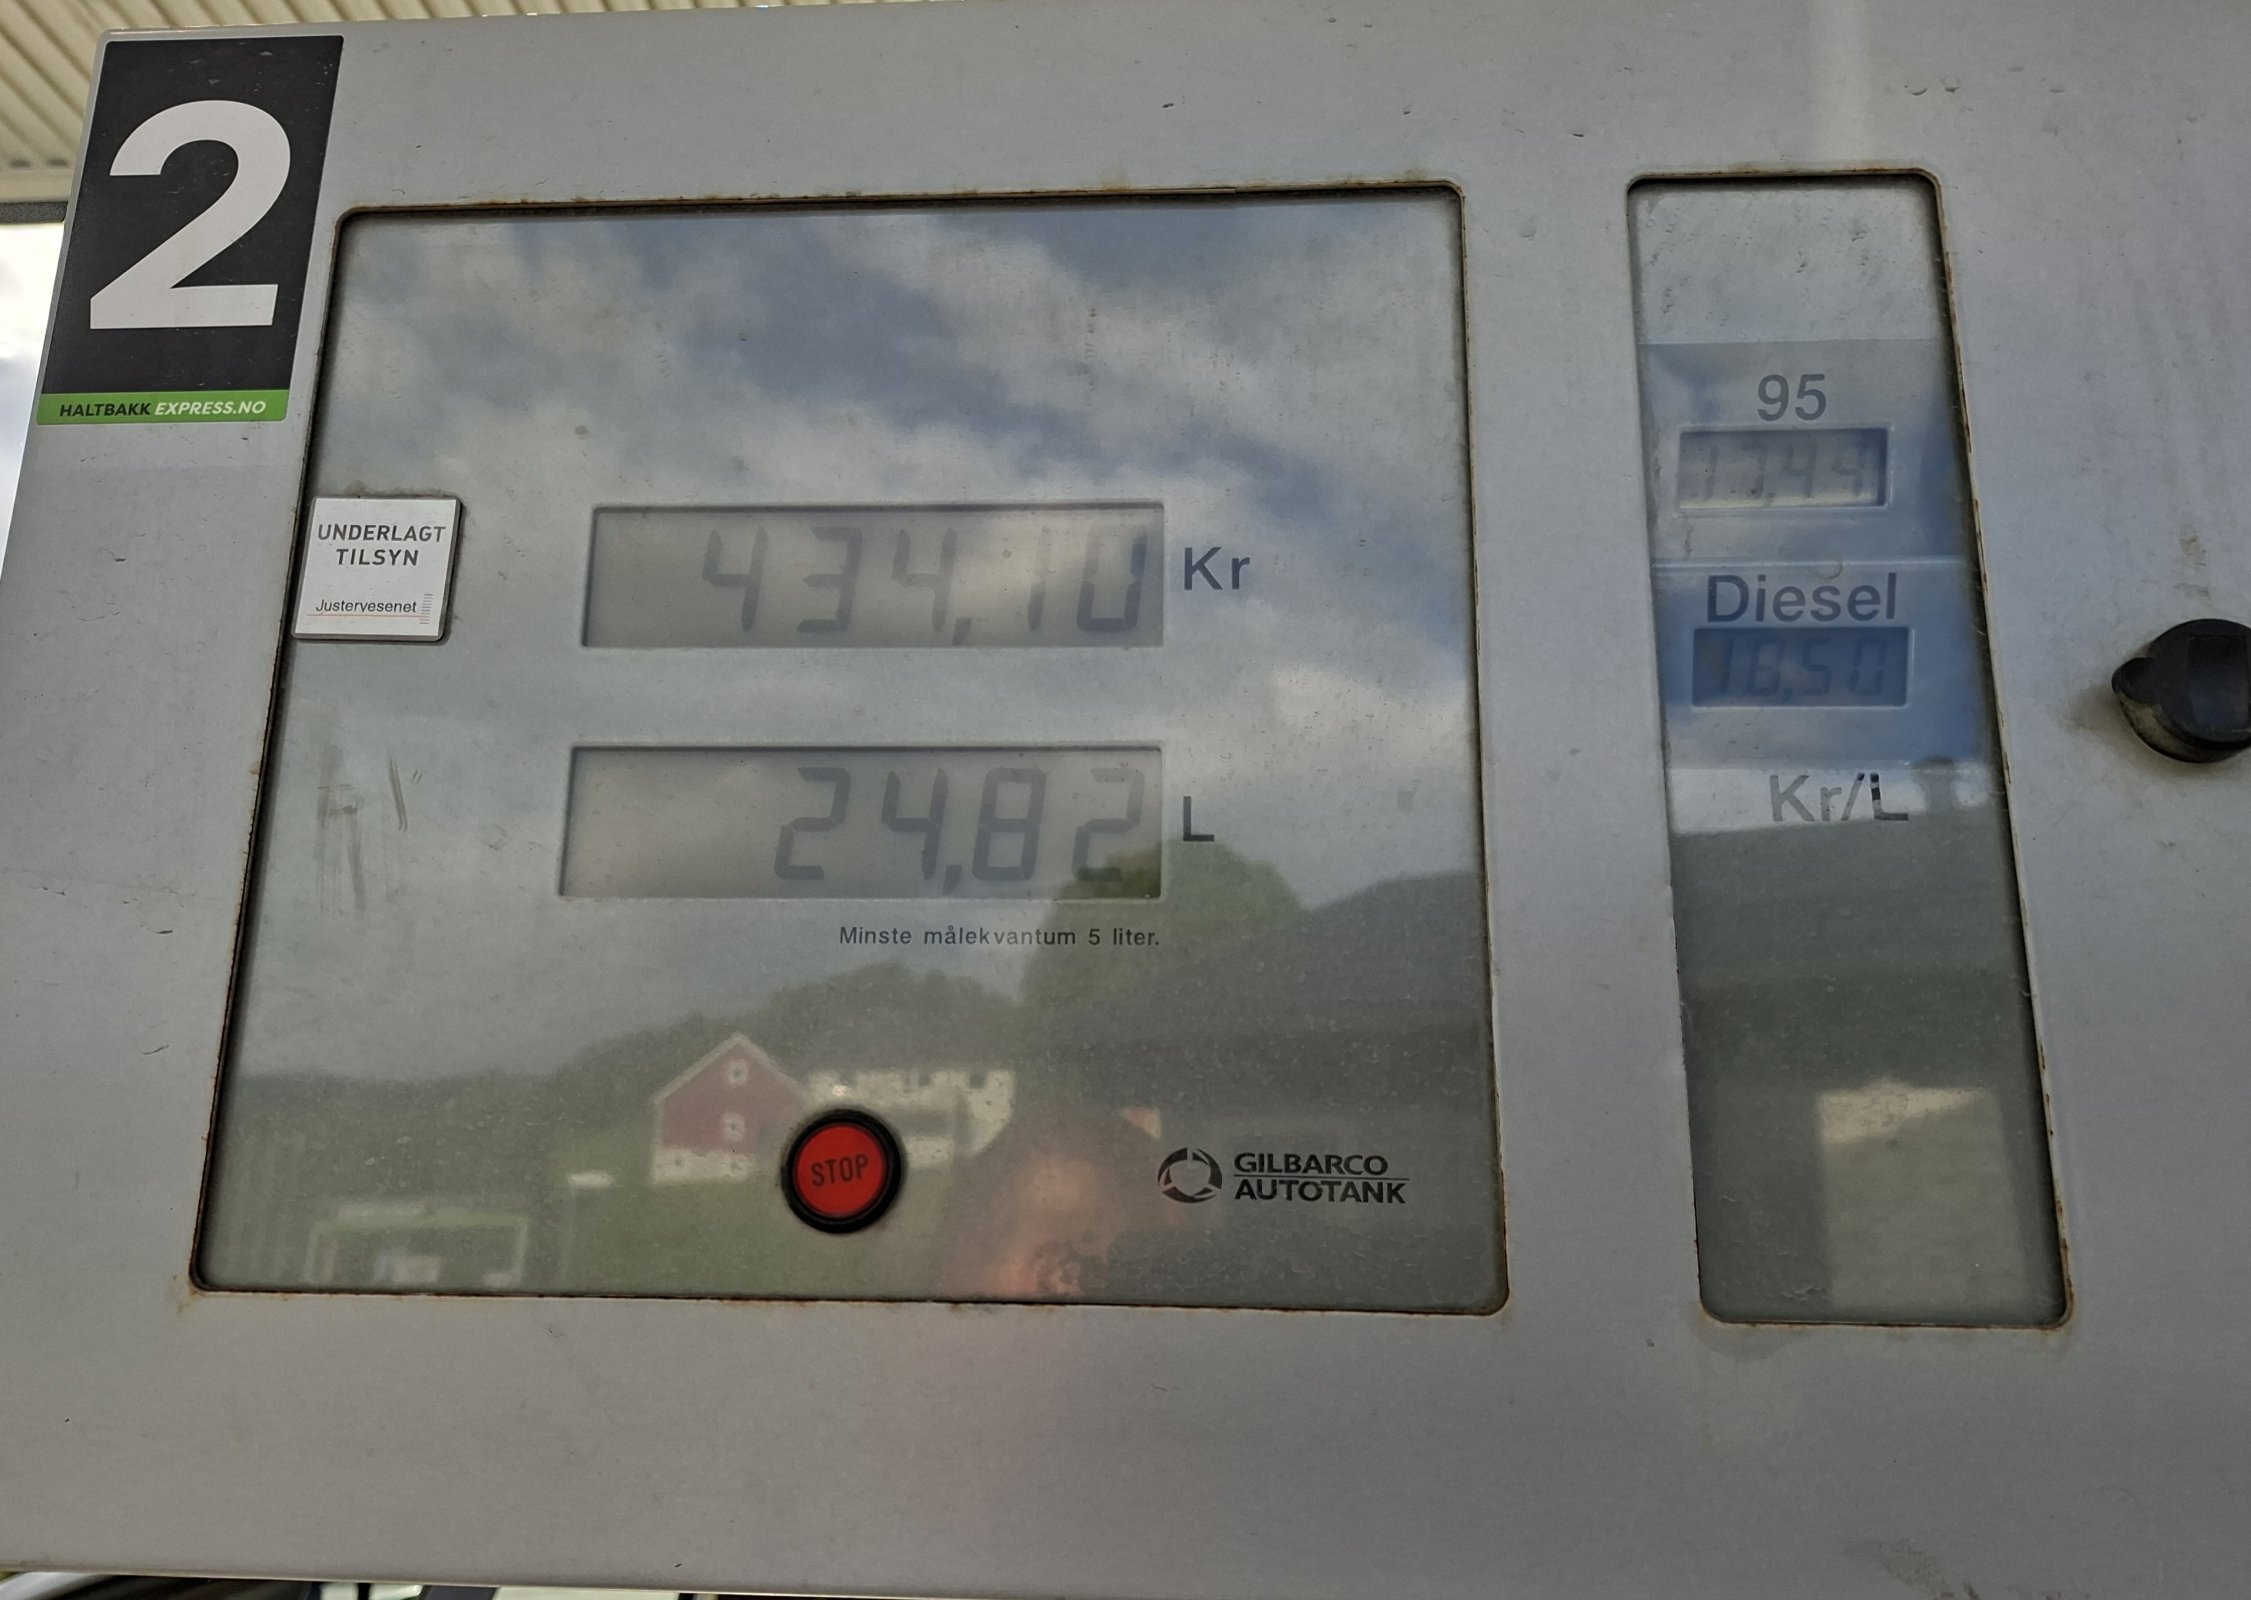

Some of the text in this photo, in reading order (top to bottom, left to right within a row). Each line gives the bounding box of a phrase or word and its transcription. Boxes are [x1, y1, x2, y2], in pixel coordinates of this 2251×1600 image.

[90, 100, 291, 330] 2
[59, 400, 266, 417] HALTBAKK EXPRESS.NO
[1757, 374, 1827, 421] 95
[318, 524, 446, 543] UNDERLAGT
[336, 549, 419, 566] TILSYN
[701, 525, 1251, 646] 434,10 Kr
[1706, 572, 1897, 622] Diesel
[315, 600, 417, 613] Justervesenet
[1769, 772, 1909, 823] Kr/L
[774, 767, 1215, 894] 24,82 L
[839, 925, 1160, 946] Minste målekvantum 5 liter.
[811, 1153, 868, 1187] STOP
[1234, 1152, 1389, 1176] GILBARCO
[1234, 1178, 1406, 1204] AUTOTANK
